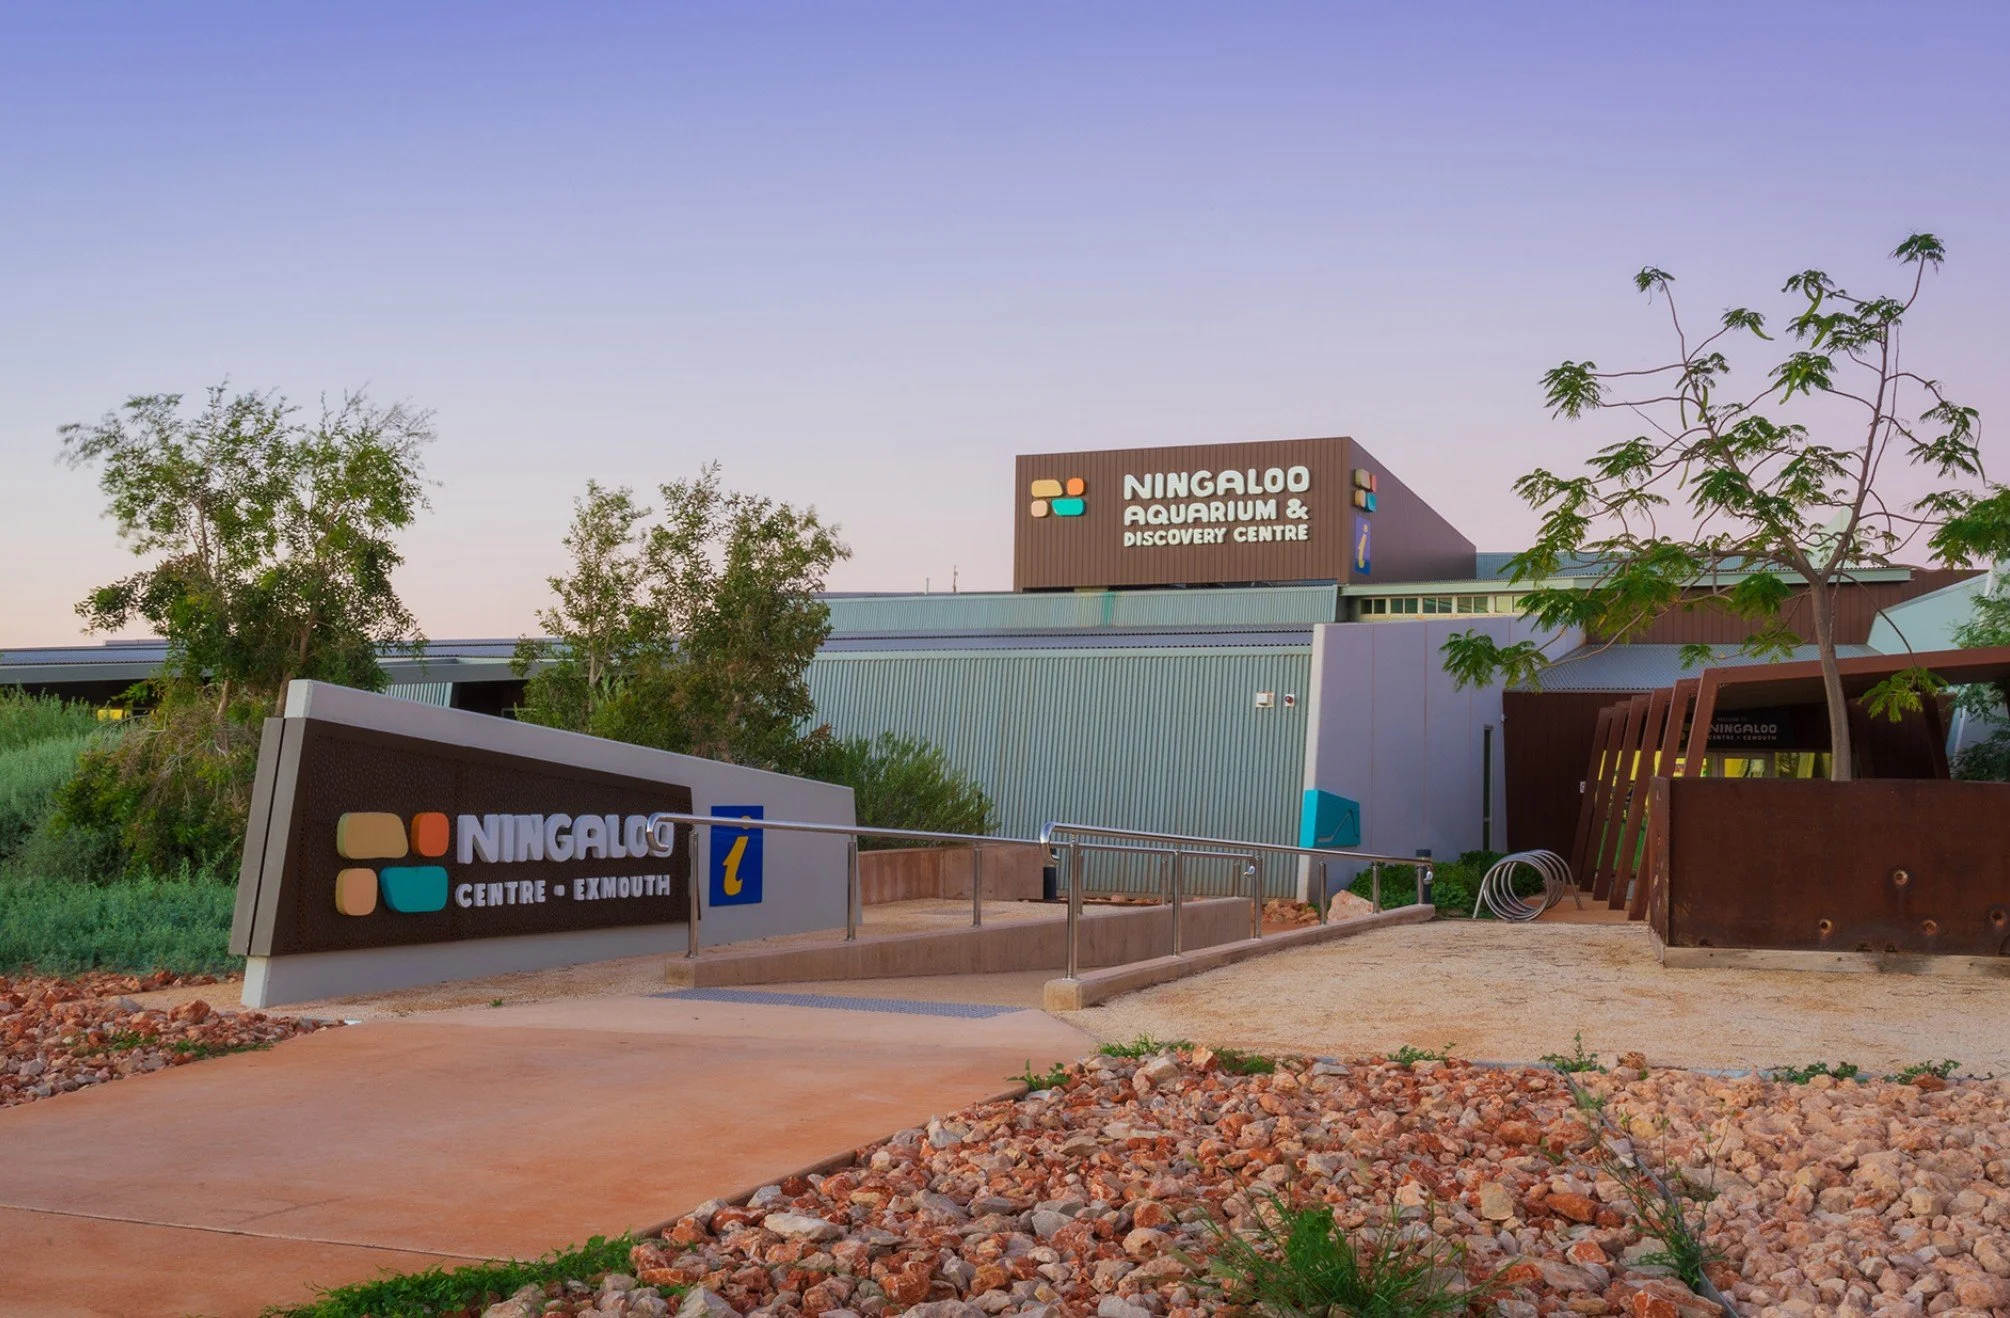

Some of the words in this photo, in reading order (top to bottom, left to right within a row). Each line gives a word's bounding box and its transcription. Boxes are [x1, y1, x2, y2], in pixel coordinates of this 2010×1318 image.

[1124, 466, 1310, 500] NINGALOO
[1124, 499, 1277, 526] AQUARIUM
[1286, 498, 1309, 520] &
[1124, 527, 1227, 547] DISCOVERY
[1233, 524, 1309, 542] CENTRE
[457, 813, 675, 864] NINGALOO
[455, 880, 546, 908] CENTRE
[573, 875, 671, 901] EXMOUTH
